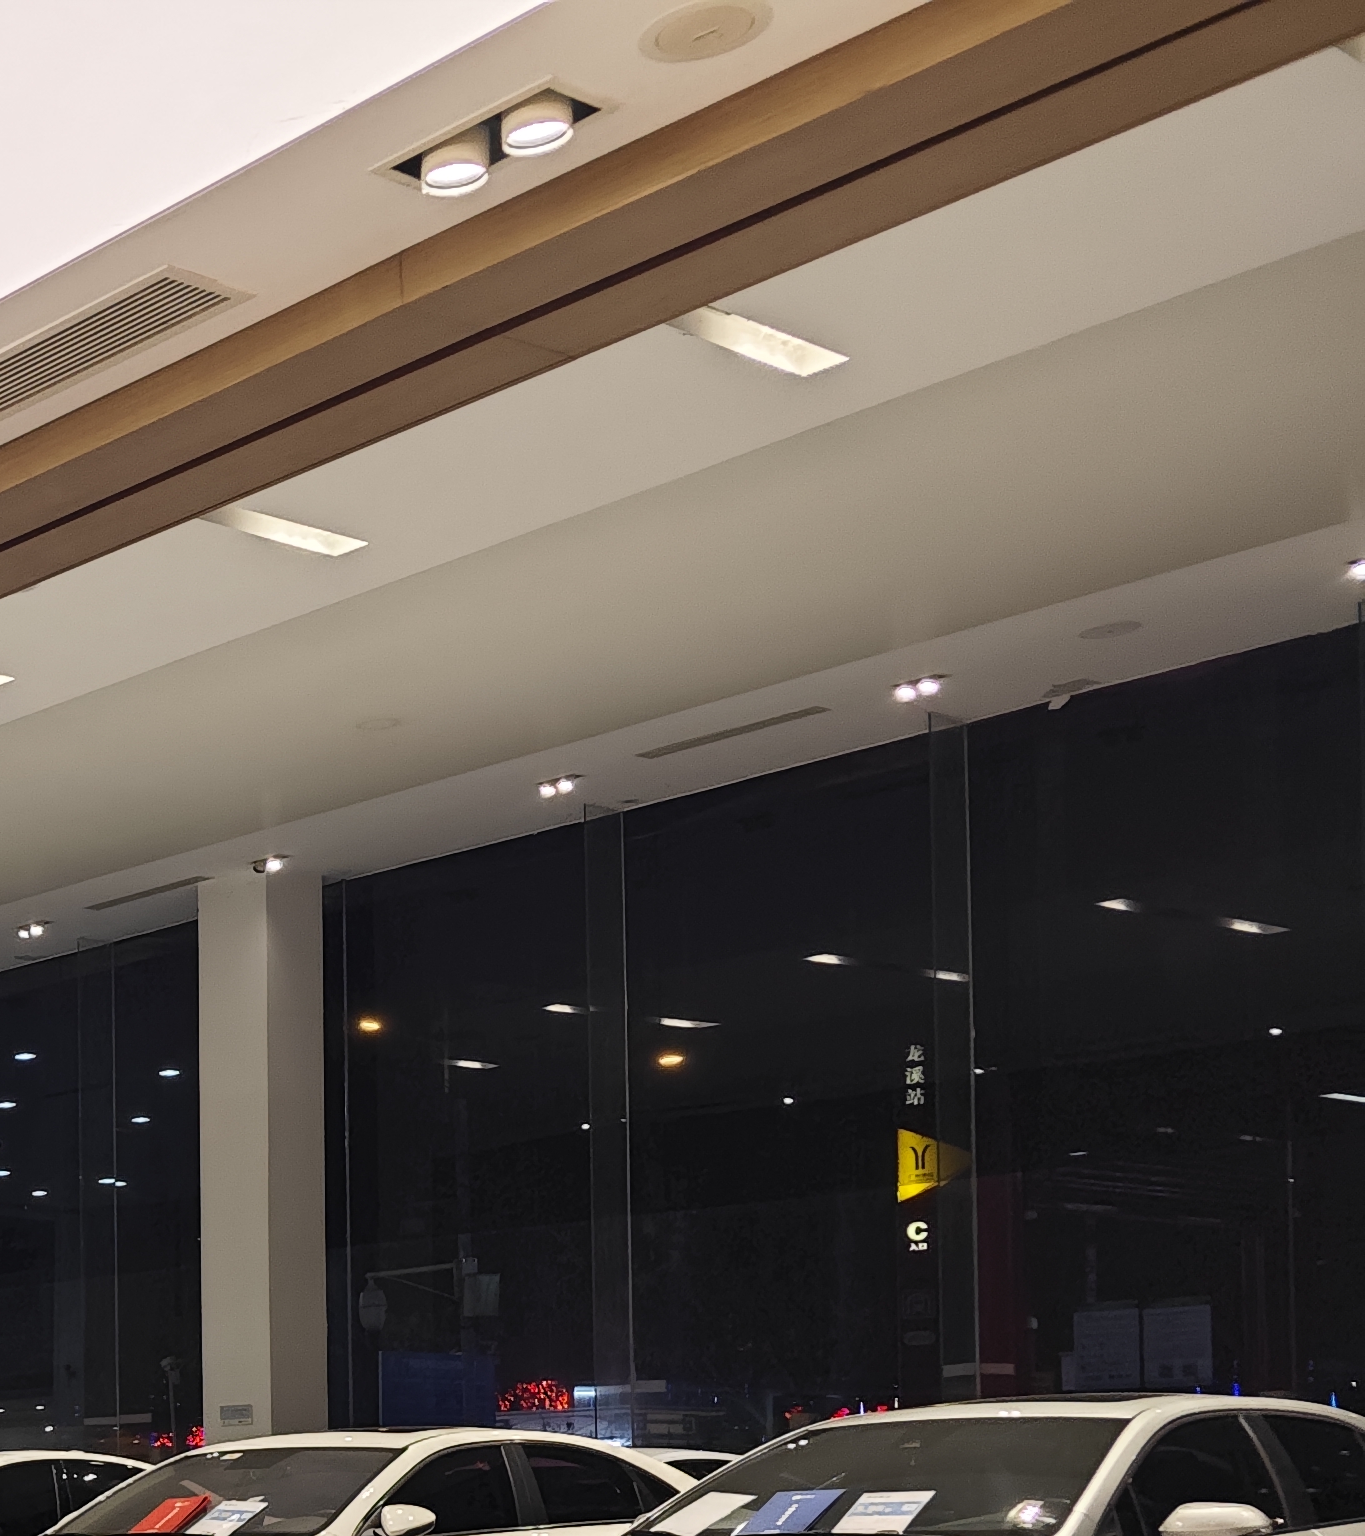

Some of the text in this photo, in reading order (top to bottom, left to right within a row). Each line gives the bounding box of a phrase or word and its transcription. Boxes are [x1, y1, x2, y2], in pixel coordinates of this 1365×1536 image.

[905, 1044, 925, 1105] 龙溪站
[906, 1221, 928, 1241] C
